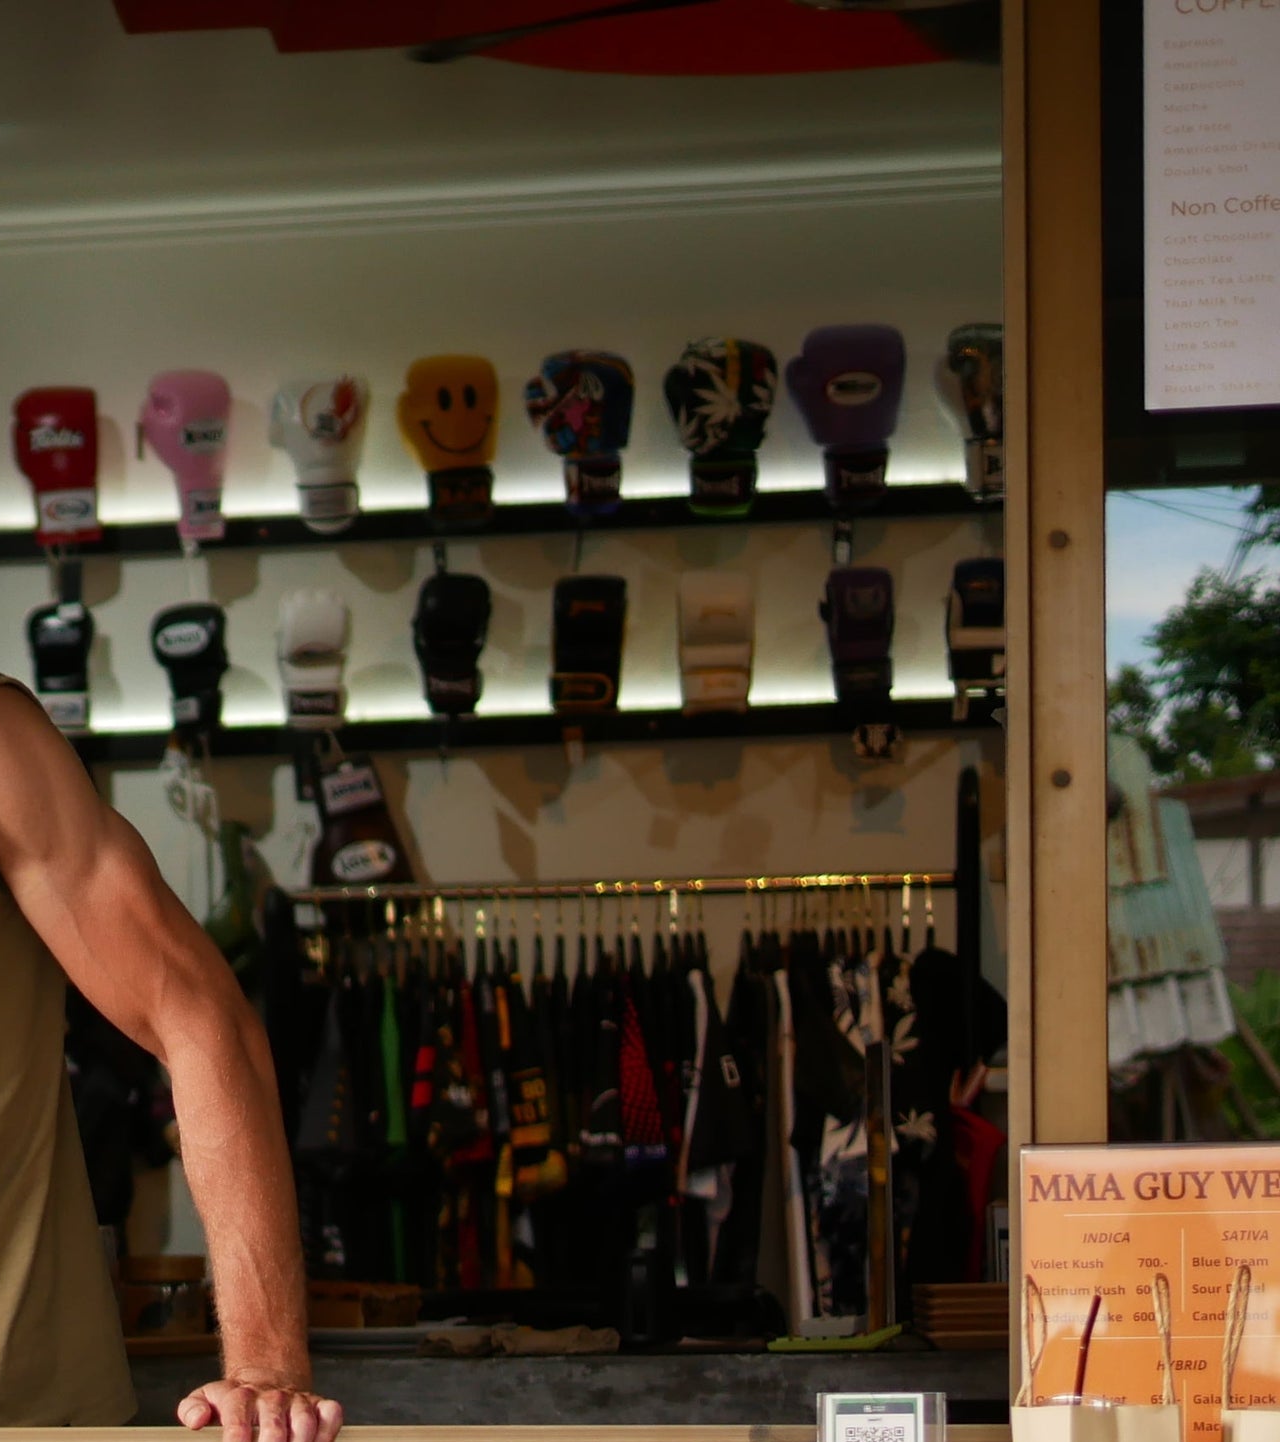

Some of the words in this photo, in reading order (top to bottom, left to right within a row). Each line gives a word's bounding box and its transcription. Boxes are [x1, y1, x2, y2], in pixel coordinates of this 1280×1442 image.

[1171, 200, 1216, 216] Non
[1029, 1173, 1125, 1202] MMA
[1133, 1171, 1214, 1200] GUY
[1083, 1232, 1130, 1243] INDICA
[1221, 1230, 1269, 1241] SATIVA
[1030, 1259, 1068, 1270] Violet
[1072, 1259, 1104, 1269] Kush
[1192, 1257, 1221, 1267] Blue
[1225, 1256, 1269, 1267] Dream
[1094, 1285, 1125, 1295] Kush
[1192, 1284, 1222, 1294] Sour
[1192, 1310, 1228, 1321] Cand
[1193, 1394, 1246, 1405] Galatic
